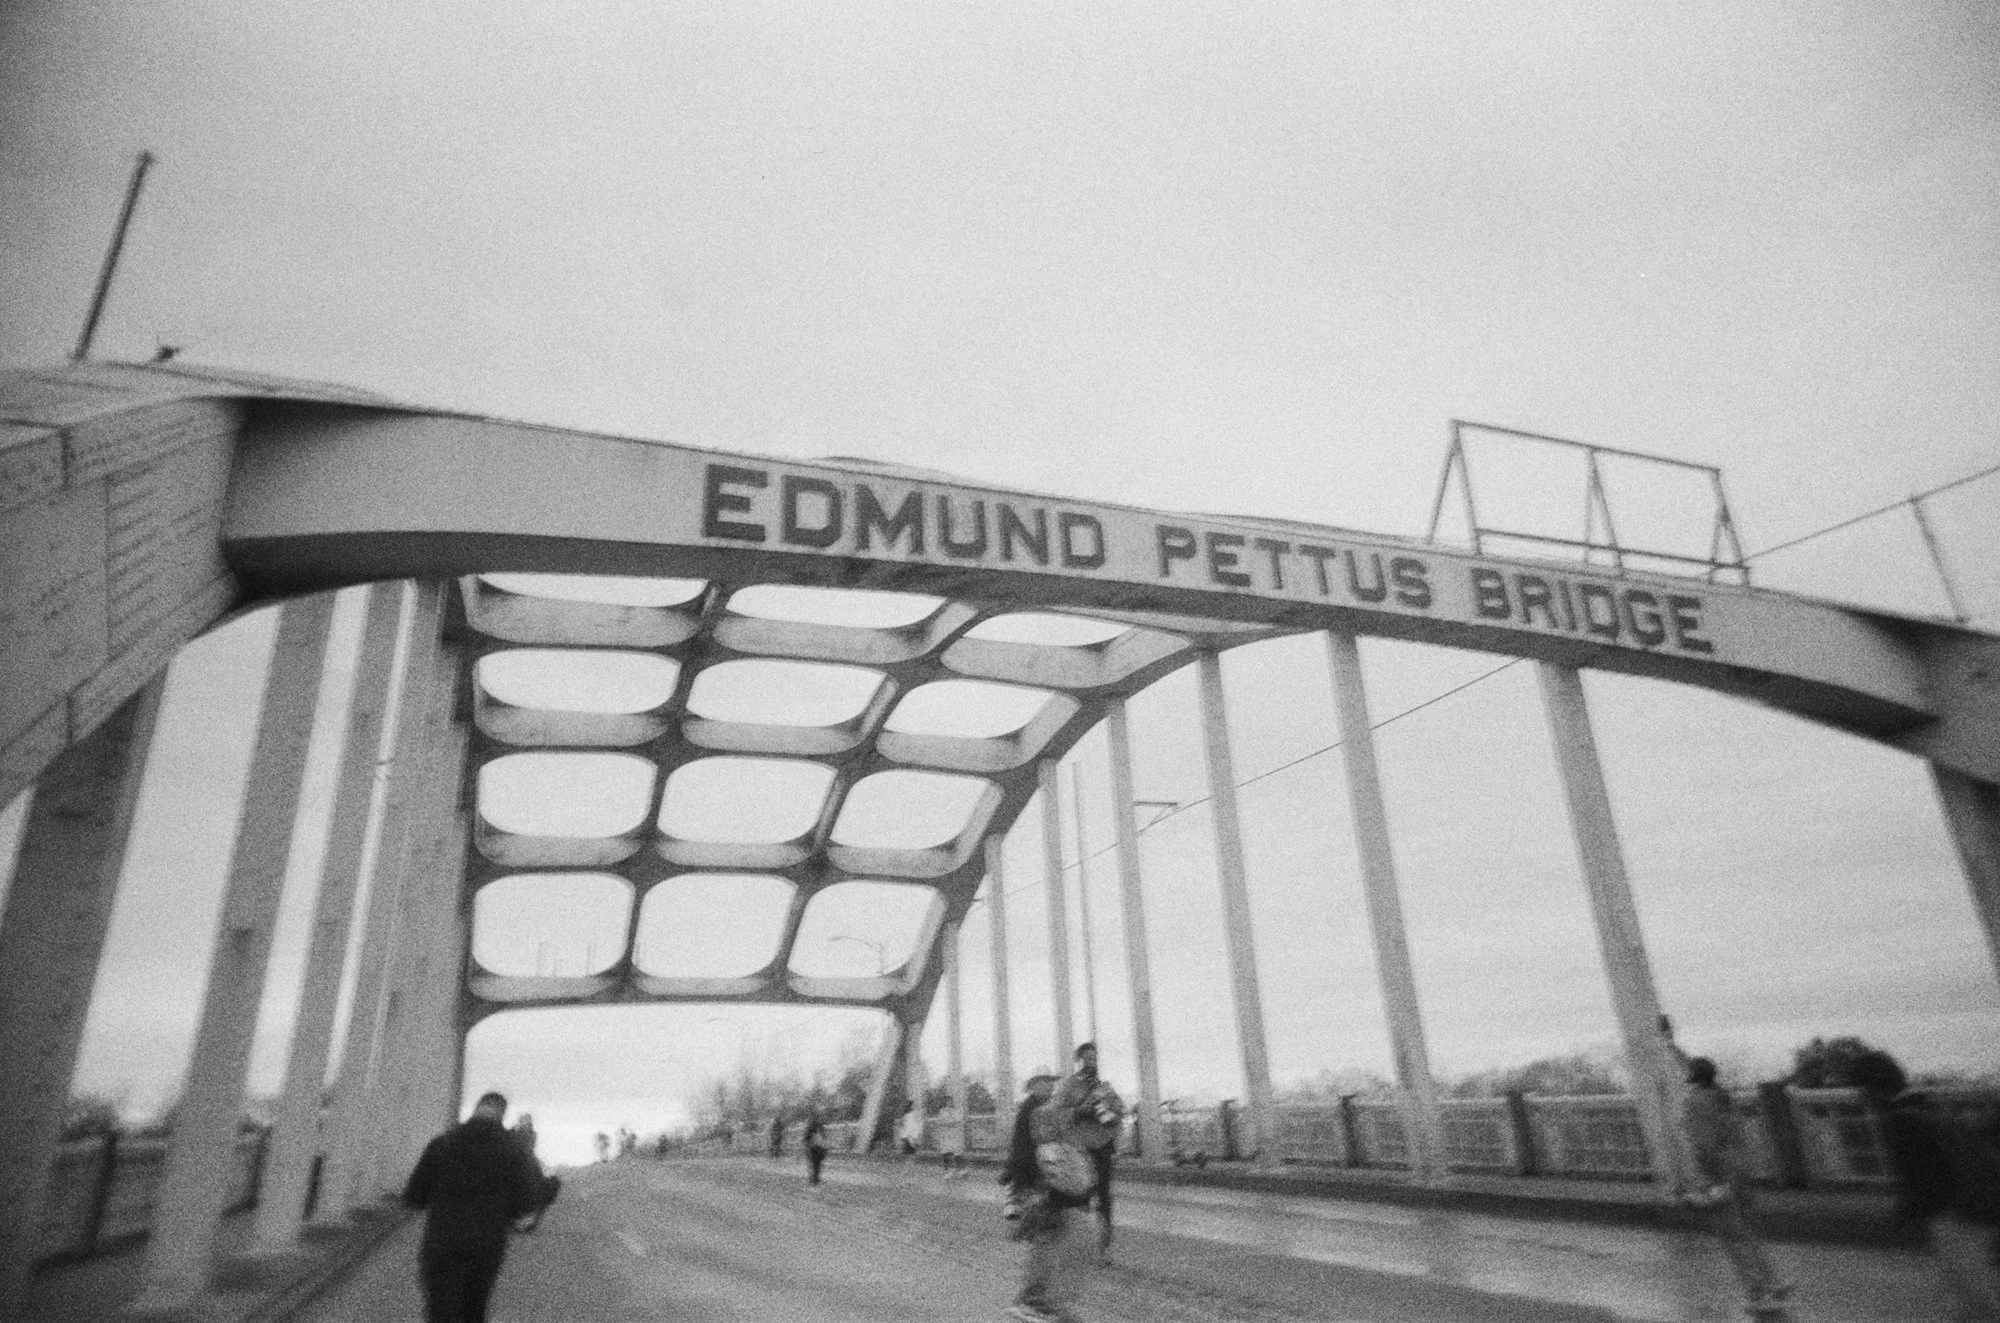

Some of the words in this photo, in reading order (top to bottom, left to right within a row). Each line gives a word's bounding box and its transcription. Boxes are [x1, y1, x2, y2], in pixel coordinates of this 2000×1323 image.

[704, 463, 1105, 570] EDMUND
[1155, 524, 1431, 609] PETTUS
[1468, 566, 1713, 654] BRIDGE
